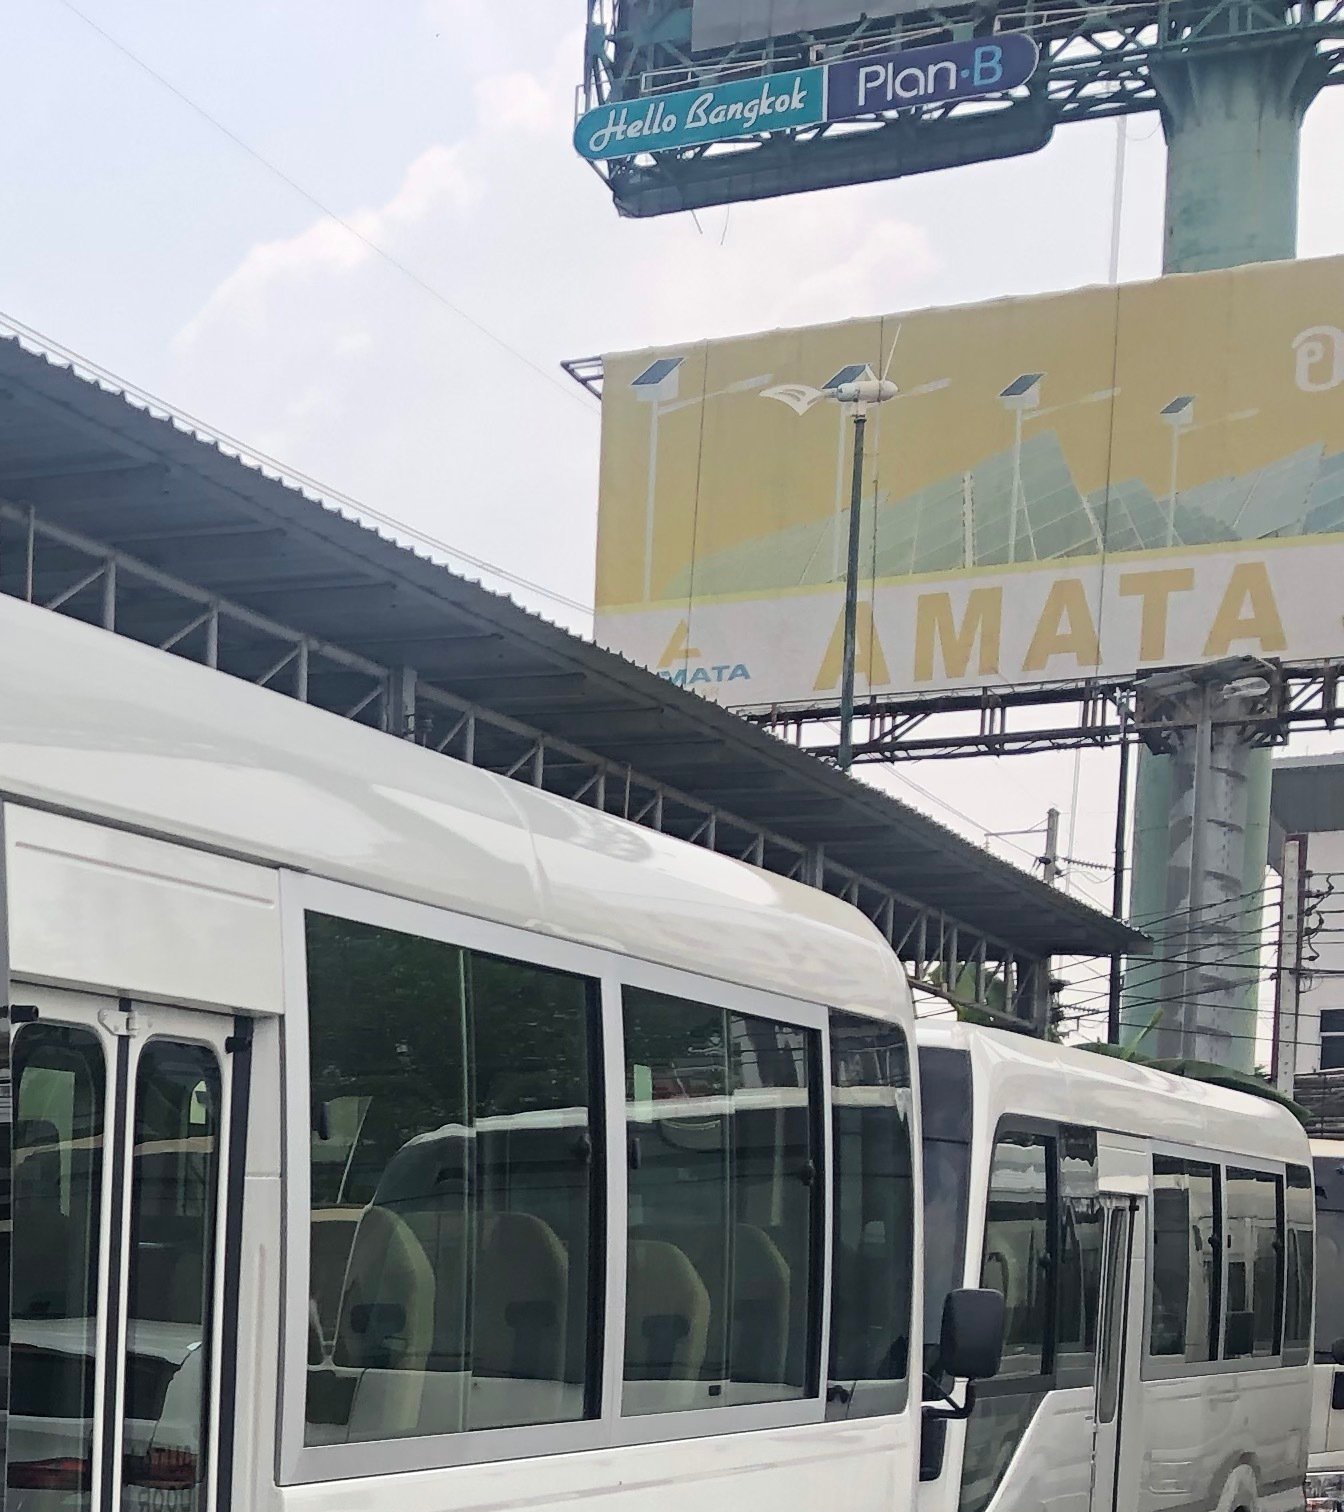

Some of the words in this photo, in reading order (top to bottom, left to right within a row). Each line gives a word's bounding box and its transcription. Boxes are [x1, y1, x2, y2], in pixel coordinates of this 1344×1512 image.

[589, 109, 677, 152] Hello
[684, 76, 808, 130] Bangkok
[813, 561, 1288, 691] AMATA
[658, 663, 751, 685] MATA
